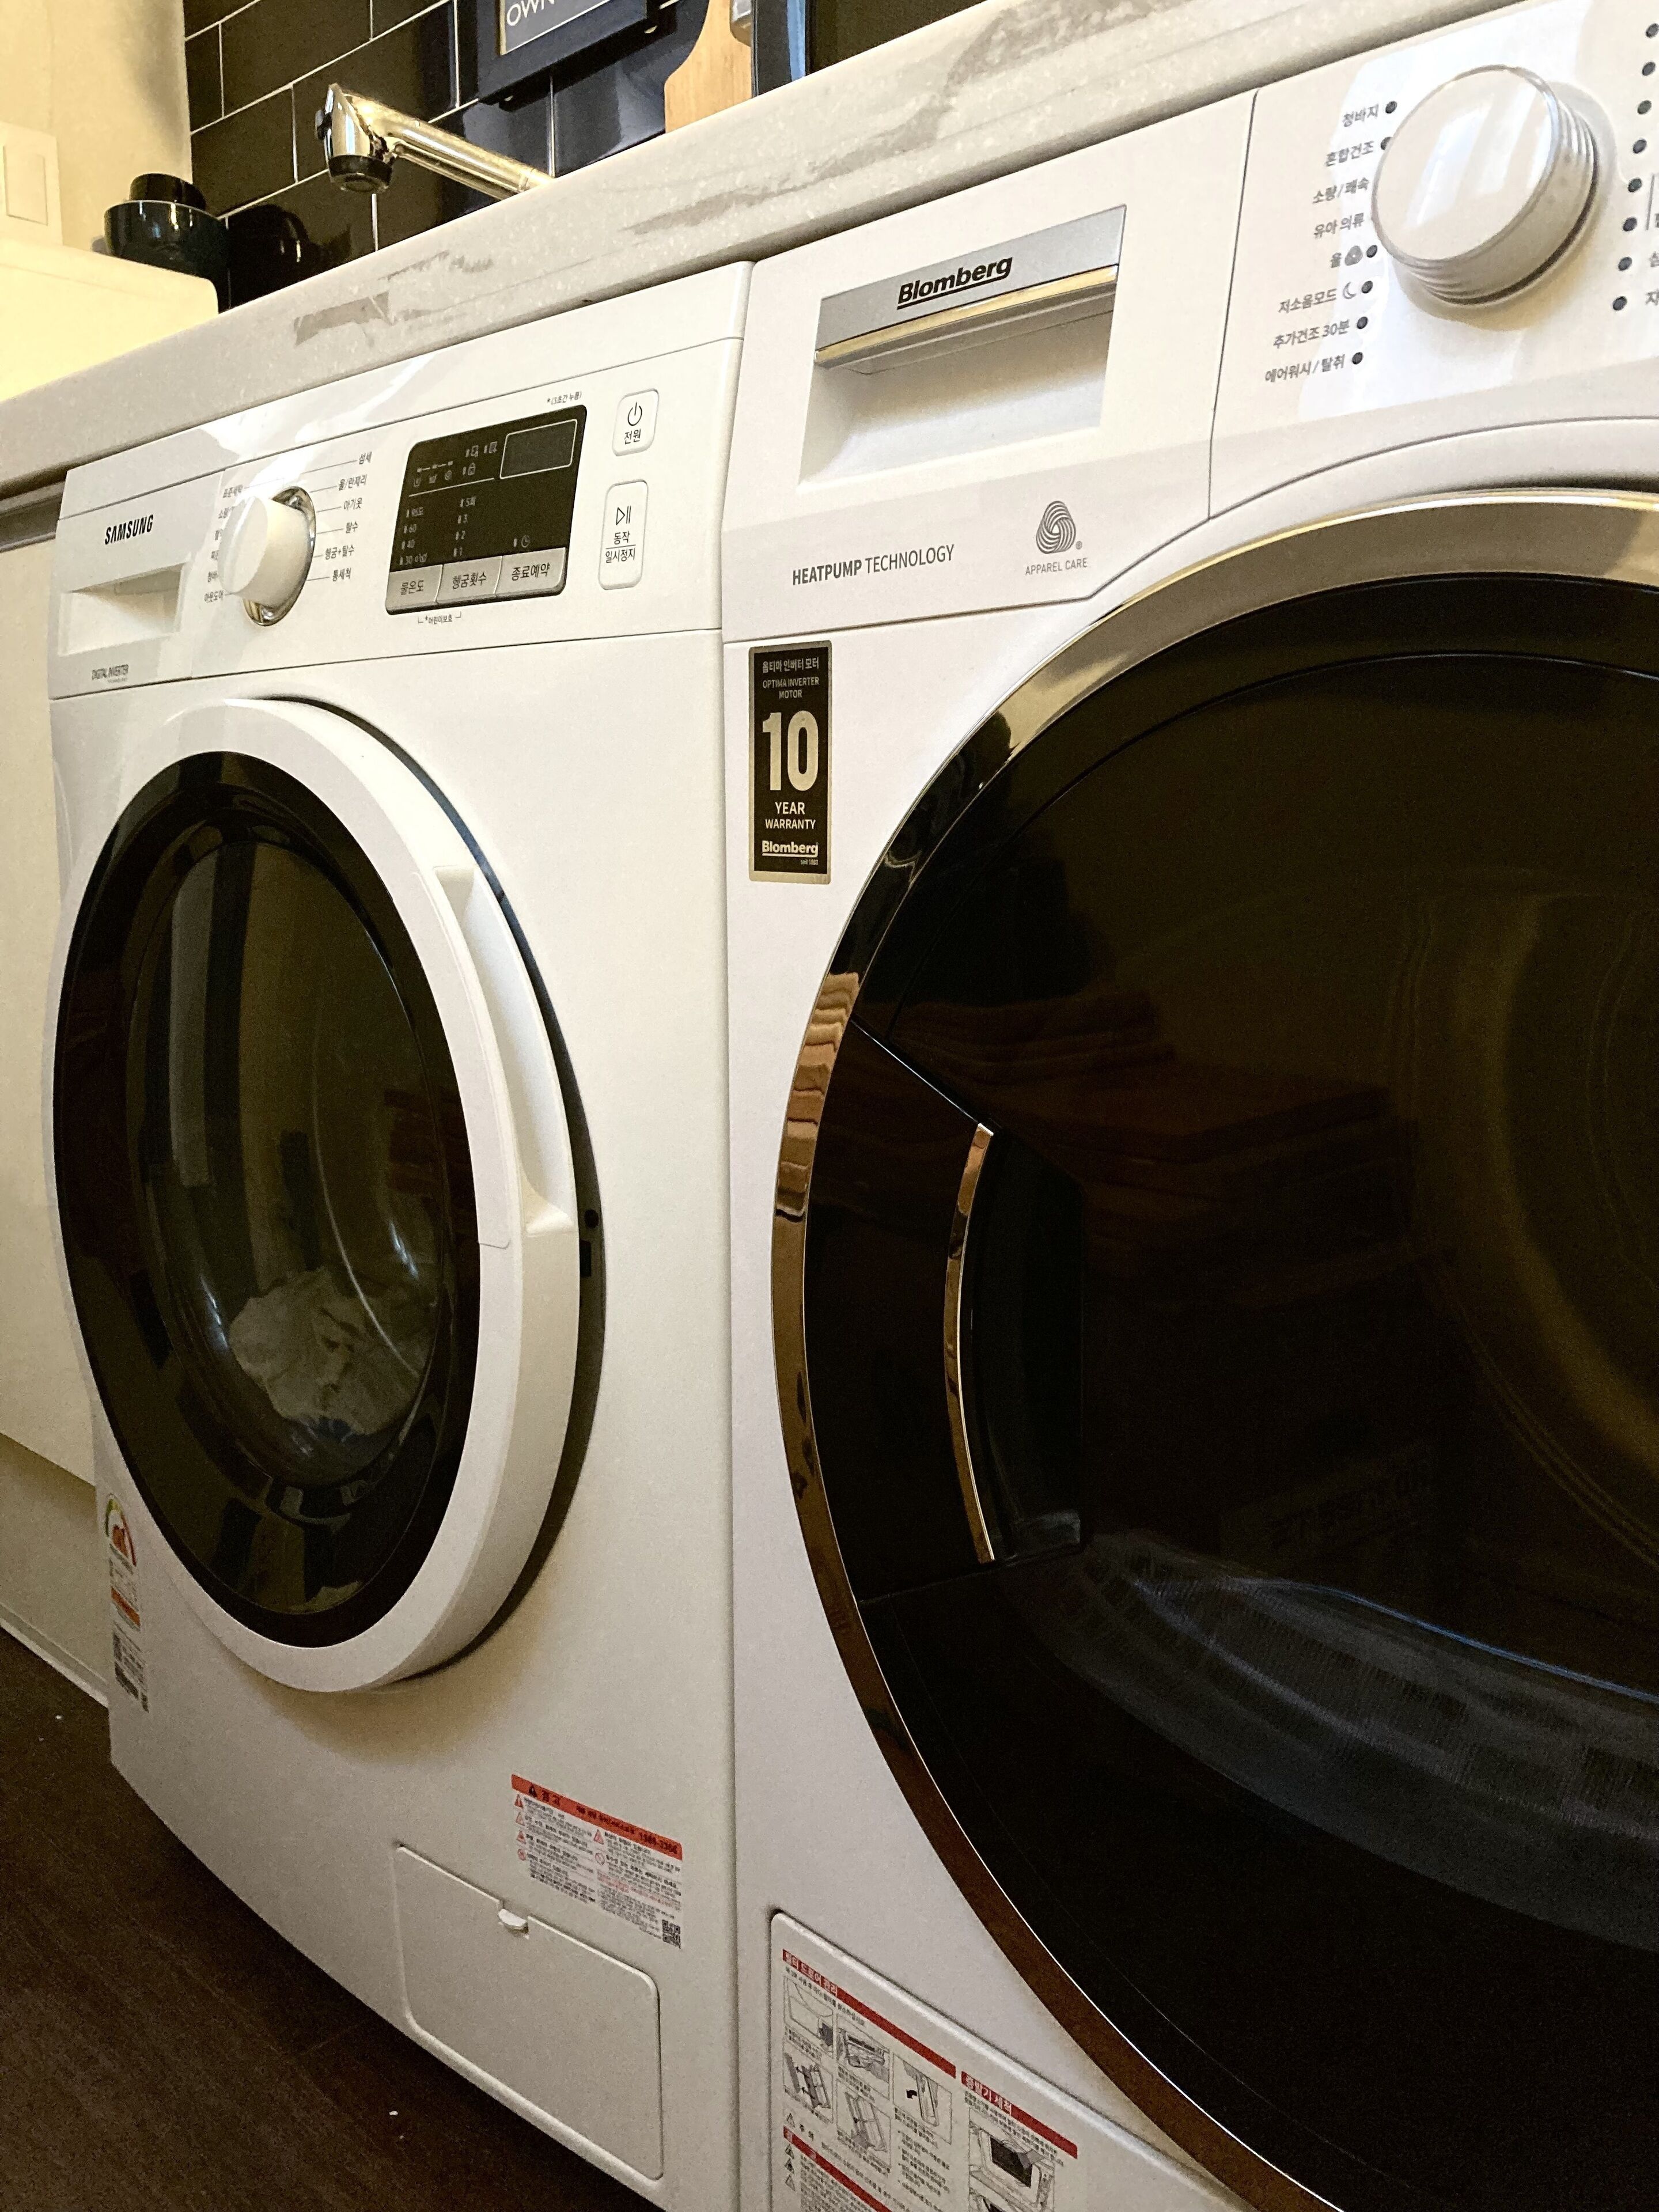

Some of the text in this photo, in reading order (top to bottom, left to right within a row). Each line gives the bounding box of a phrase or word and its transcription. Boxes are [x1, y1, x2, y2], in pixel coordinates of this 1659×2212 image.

[1325, 141, 1374, 167] 혼합건조
[1313, 212, 1365, 240] 유아 의류
[897, 257, 1013, 310] Blomberg
[1278, 288, 1338, 314] 저소음모드
[1273, 318, 1350, 349] 추가건조 30분
[624, 428, 641, 445] 전원
[359, 451, 373, 465] 섬세
[343, 497, 362, 512] 아기옷
[105, 514, 153, 545] SAMSUNG
[613, 531, 630, 546] 동작
[605, 548, 635, 564] 일시정지
[792, 544, 955, 586] HEATPUMP TECHNOLOGY
[512, 562, 550, 581] 종료예약
[1025, 557, 1088, 576] APPAREL CARE
[401, 579, 424, 595] 물온도
[452, 571, 487, 590] 헹굼횟수
[762, 657, 819, 673] 옵티마 인버터 모터
[763, 676, 819, 688] OPTIMA INVERTER
[779, 690, 802, 699] MOTOR
[763, 710, 819, 792] 10
[775, 801, 805, 815] YEAR
[765, 819, 816, 830] WARRANTY
[762, 840, 819, 858] Blomberg
